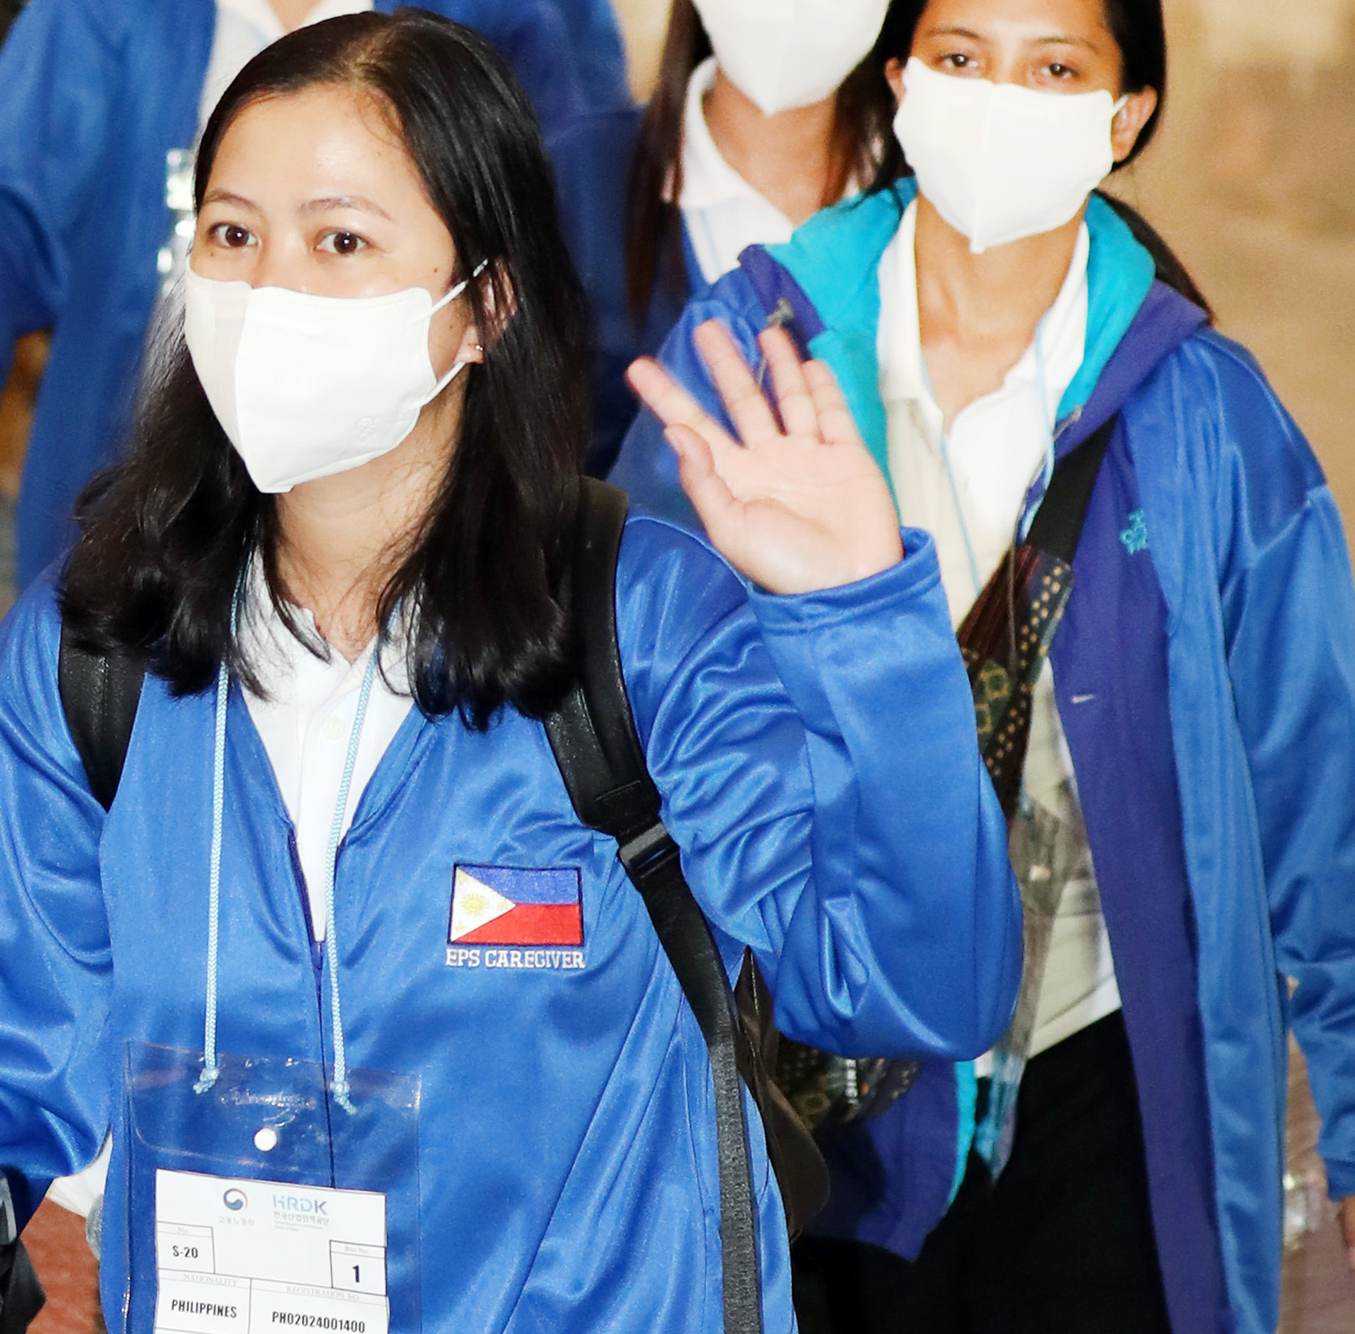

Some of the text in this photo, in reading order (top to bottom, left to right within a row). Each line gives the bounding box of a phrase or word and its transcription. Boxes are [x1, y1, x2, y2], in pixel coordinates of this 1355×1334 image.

[445, 948, 586, 969] EPS CAREGIVER
[272, 1194, 328, 1215] HRDK
[172, 1245, 198, 1258] S-20
[183, 1273, 238, 1287] NATIONALITY
[352, 1265, 360, 1283] 1
[286, 1285, 344, 1299] REGISTRATION
[171, 1299, 238, 1318] PHILIPPINES
